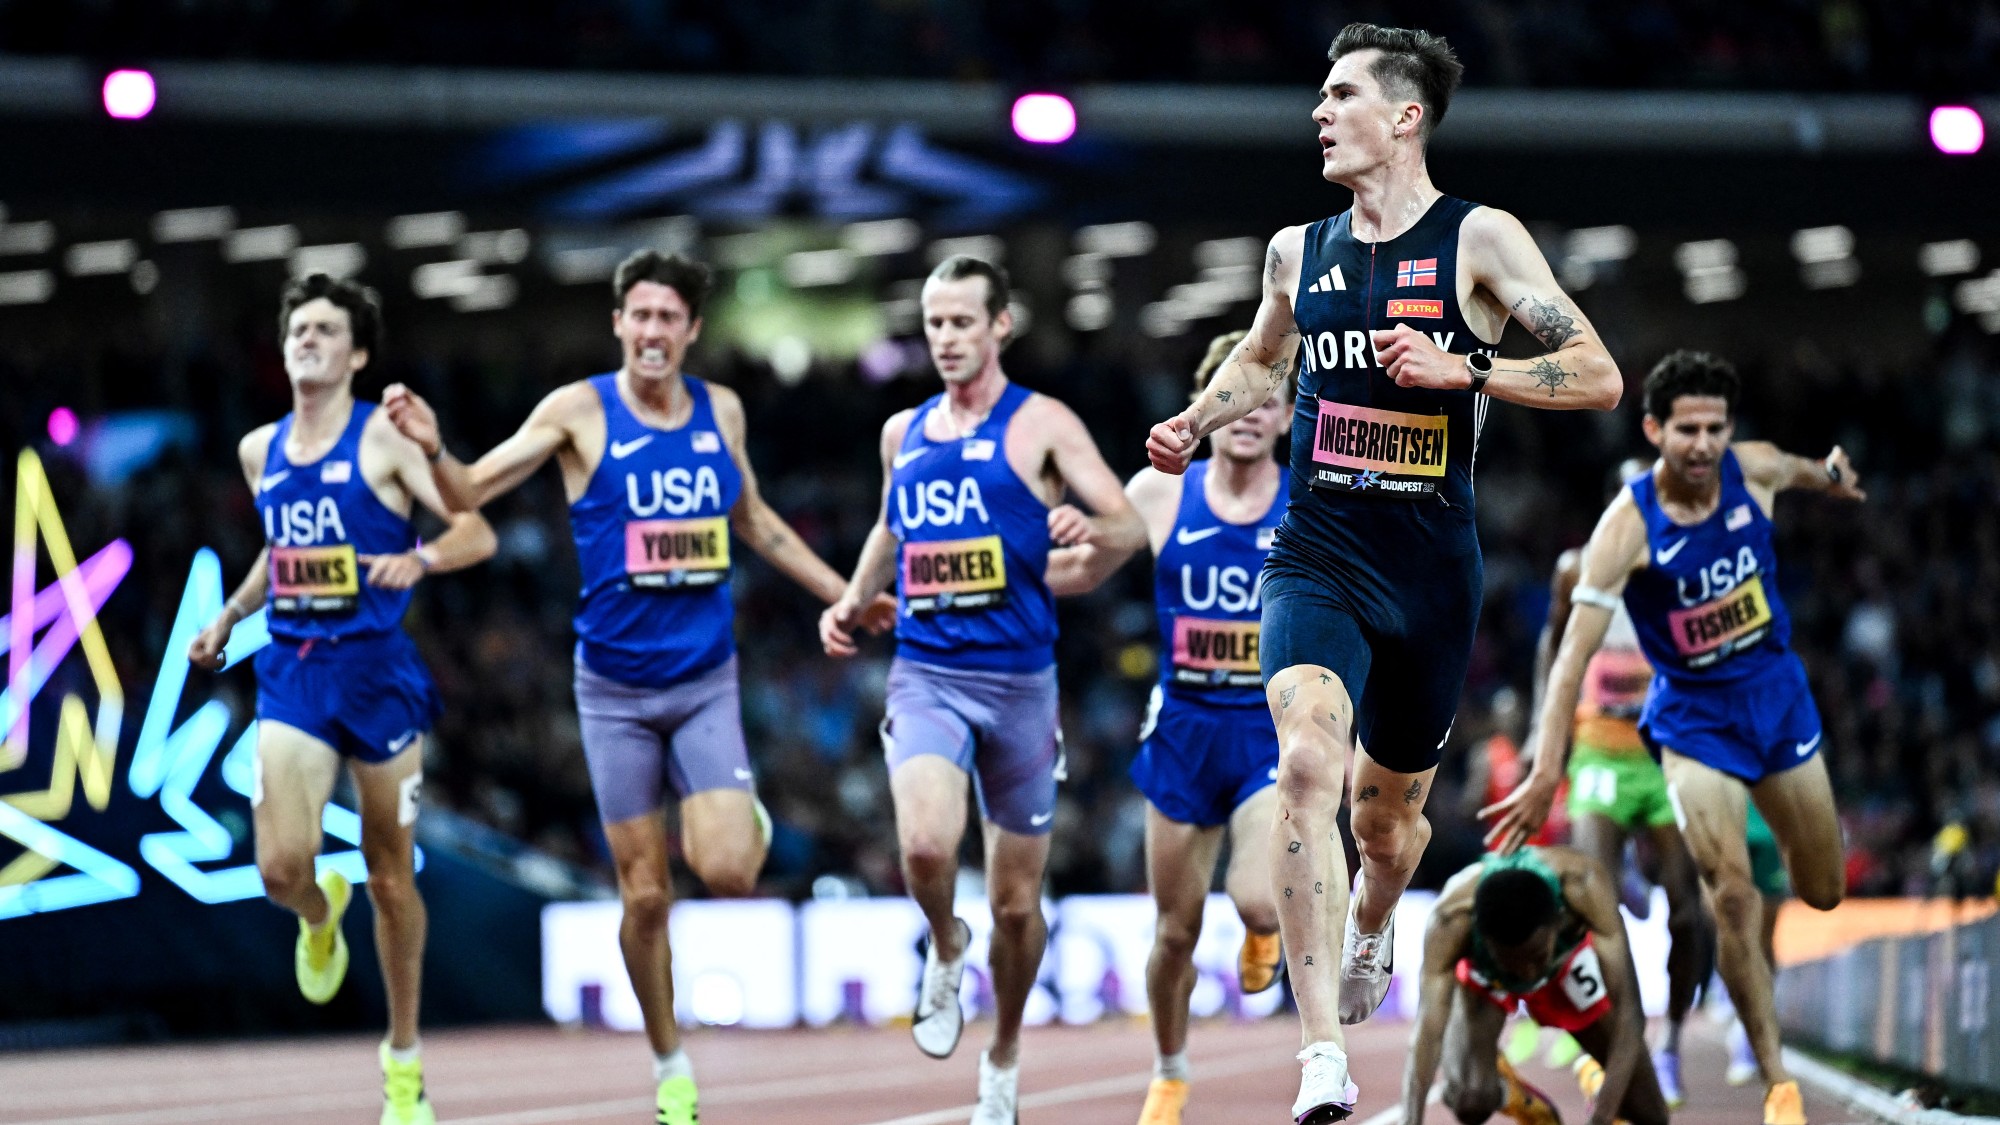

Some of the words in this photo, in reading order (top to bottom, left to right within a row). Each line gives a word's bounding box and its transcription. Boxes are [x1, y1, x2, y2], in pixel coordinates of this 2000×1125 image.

[1406, 304, 1439, 313] EXTRA
[1302, 330, 1455, 374] NORY
[1318, 413, 1444, 466] INGEBRIGTSEN
[625, 465, 721, 517] USA
[897, 476, 990, 529] USA
[1318, 470, 1352, 485] ULTIMATE
[1380, 480, 1423, 492] BUDAPEST
[264, 496, 346, 547] USA
[642, 530, 717, 562] YOUNG
[909, 550, 996, 584] HOCKER
[1677, 545, 1758, 607] USA
[1683, 592, 1759, 646] FISHER
[1187, 628, 1260, 661] WOLF
[1572, 964, 1598, 997] 5
